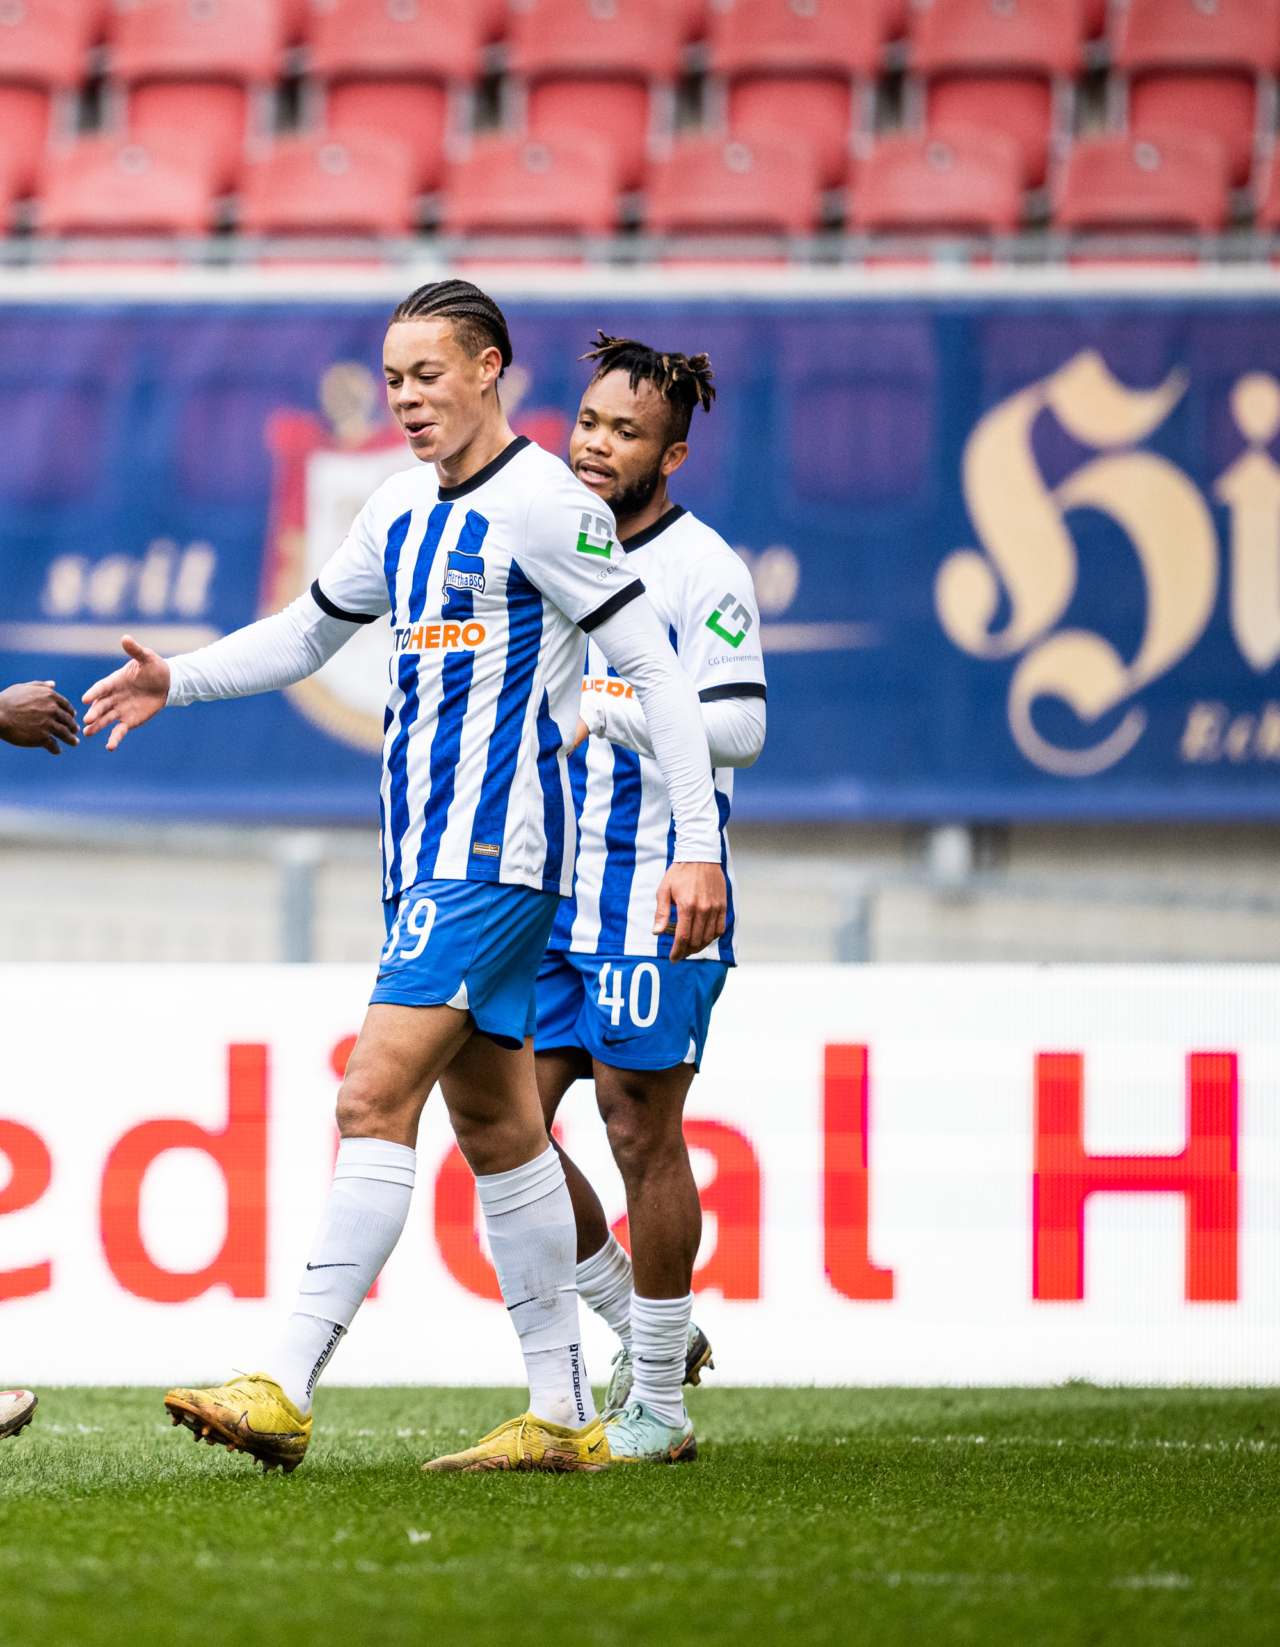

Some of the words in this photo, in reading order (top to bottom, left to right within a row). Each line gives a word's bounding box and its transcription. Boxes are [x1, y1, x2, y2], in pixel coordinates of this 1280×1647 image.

[708, 656, 720, 666] CG
[597, 962, 660, 1028] 40
[1032, 1052, 1238, 1302] H
